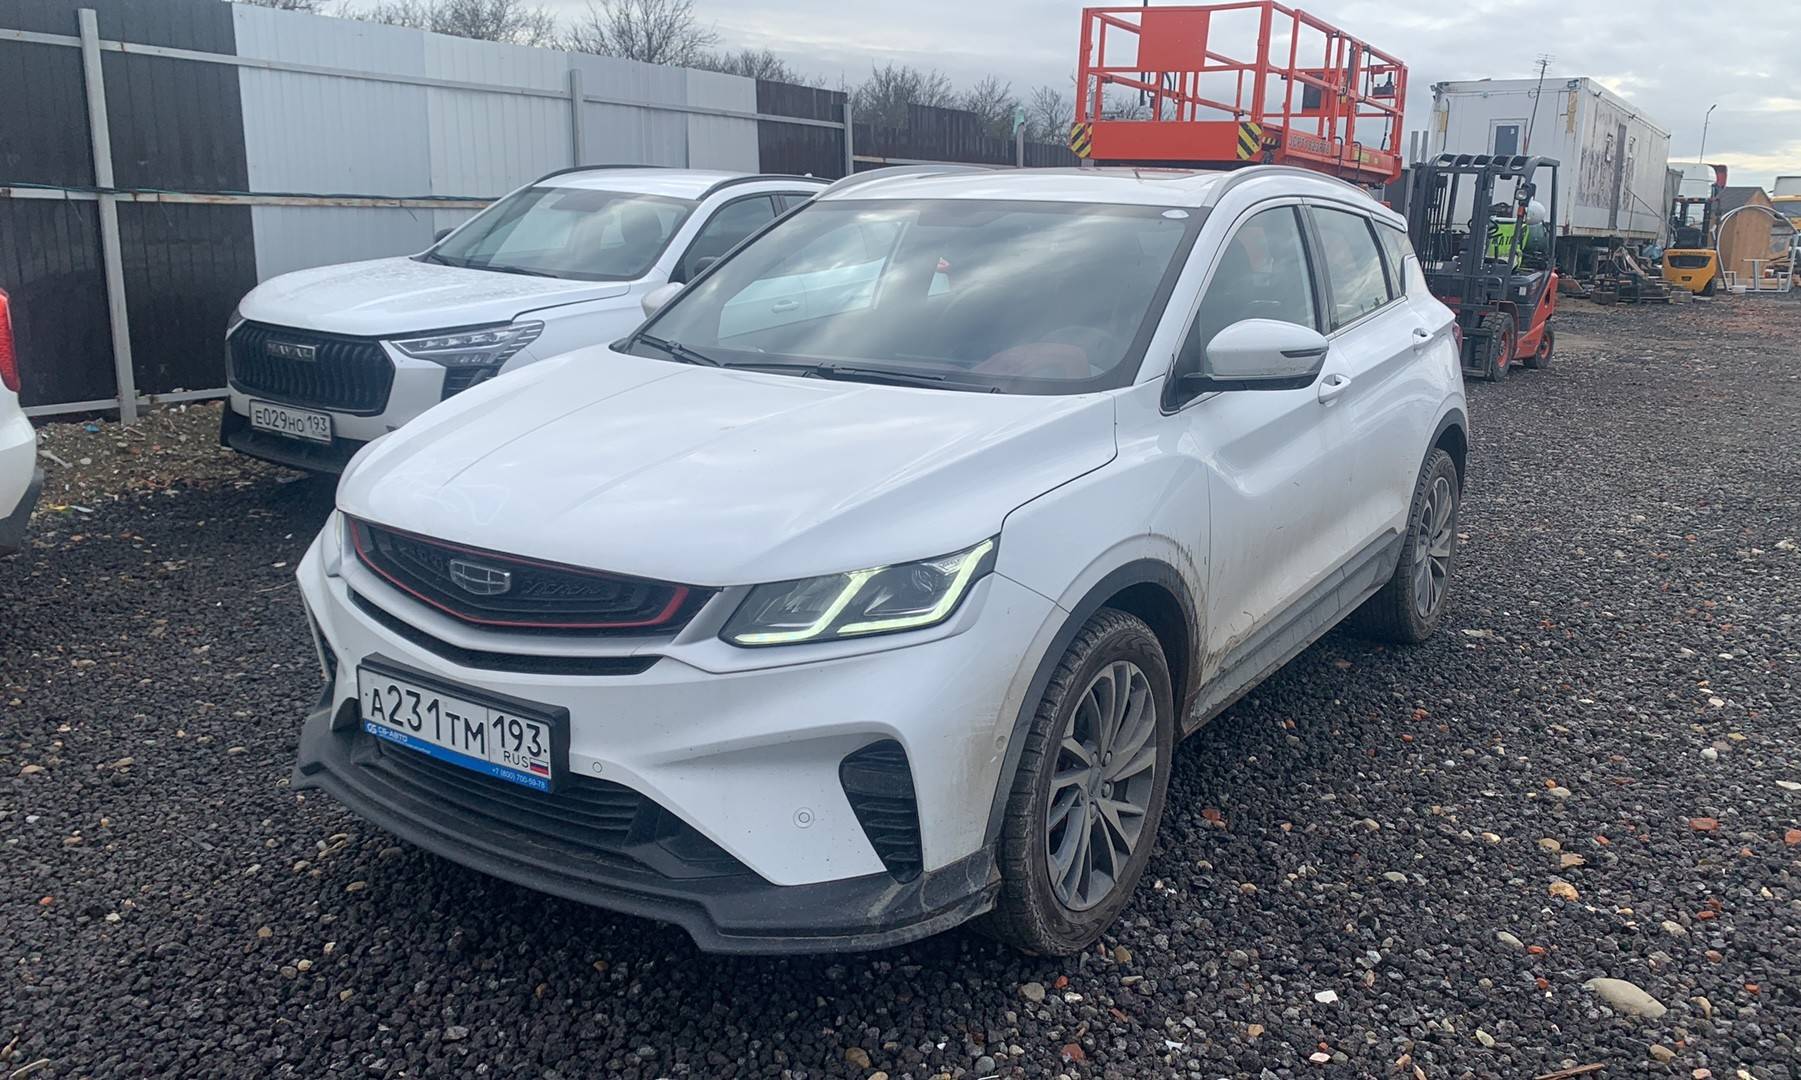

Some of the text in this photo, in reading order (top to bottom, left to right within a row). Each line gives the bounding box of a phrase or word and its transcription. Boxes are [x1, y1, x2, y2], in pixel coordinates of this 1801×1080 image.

[307, 415, 327, 431] 193
[371, 685, 541, 757] А231ТМ 193
[504, 750, 529, 768] RUS
